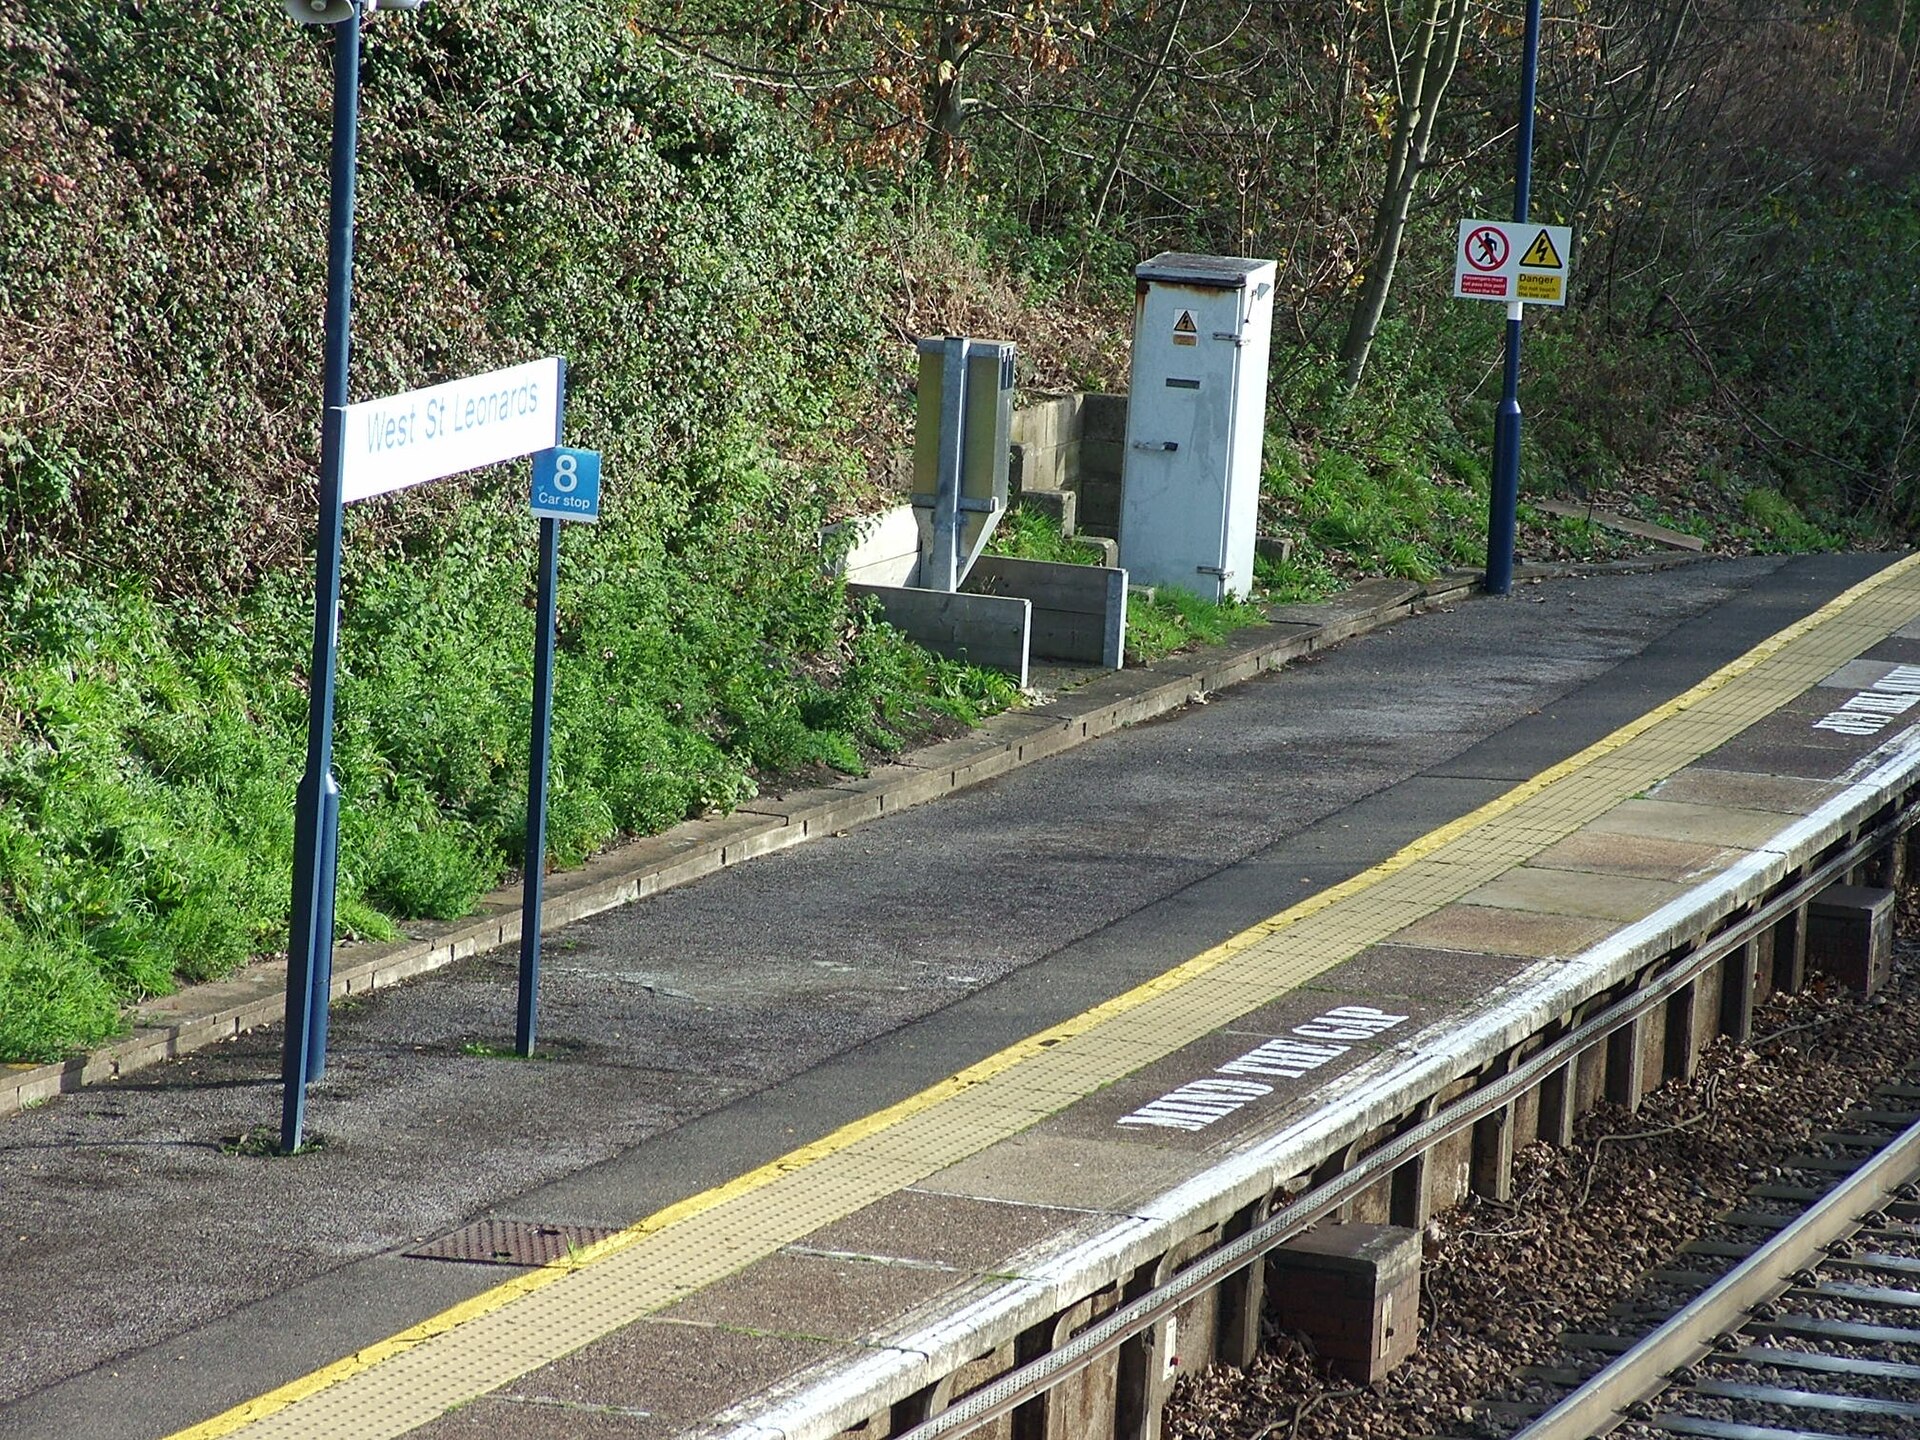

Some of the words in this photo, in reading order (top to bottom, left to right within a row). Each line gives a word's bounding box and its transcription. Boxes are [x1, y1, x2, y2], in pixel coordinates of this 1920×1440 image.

[1519, 273, 1554, 285] Danger
[367, 403, 416, 454] West
[425, 398, 446, 439] St
[454, 375, 539, 432] Leonards
[553, 454, 578, 493] 8
[538, 491, 561, 505] Car
[563, 496, 590, 511] stop
[1113, 1079, 1275, 1132] MIND
[1214, 1038, 1352, 1079] THE
[1291, 1006, 1410, 1040] GAP
